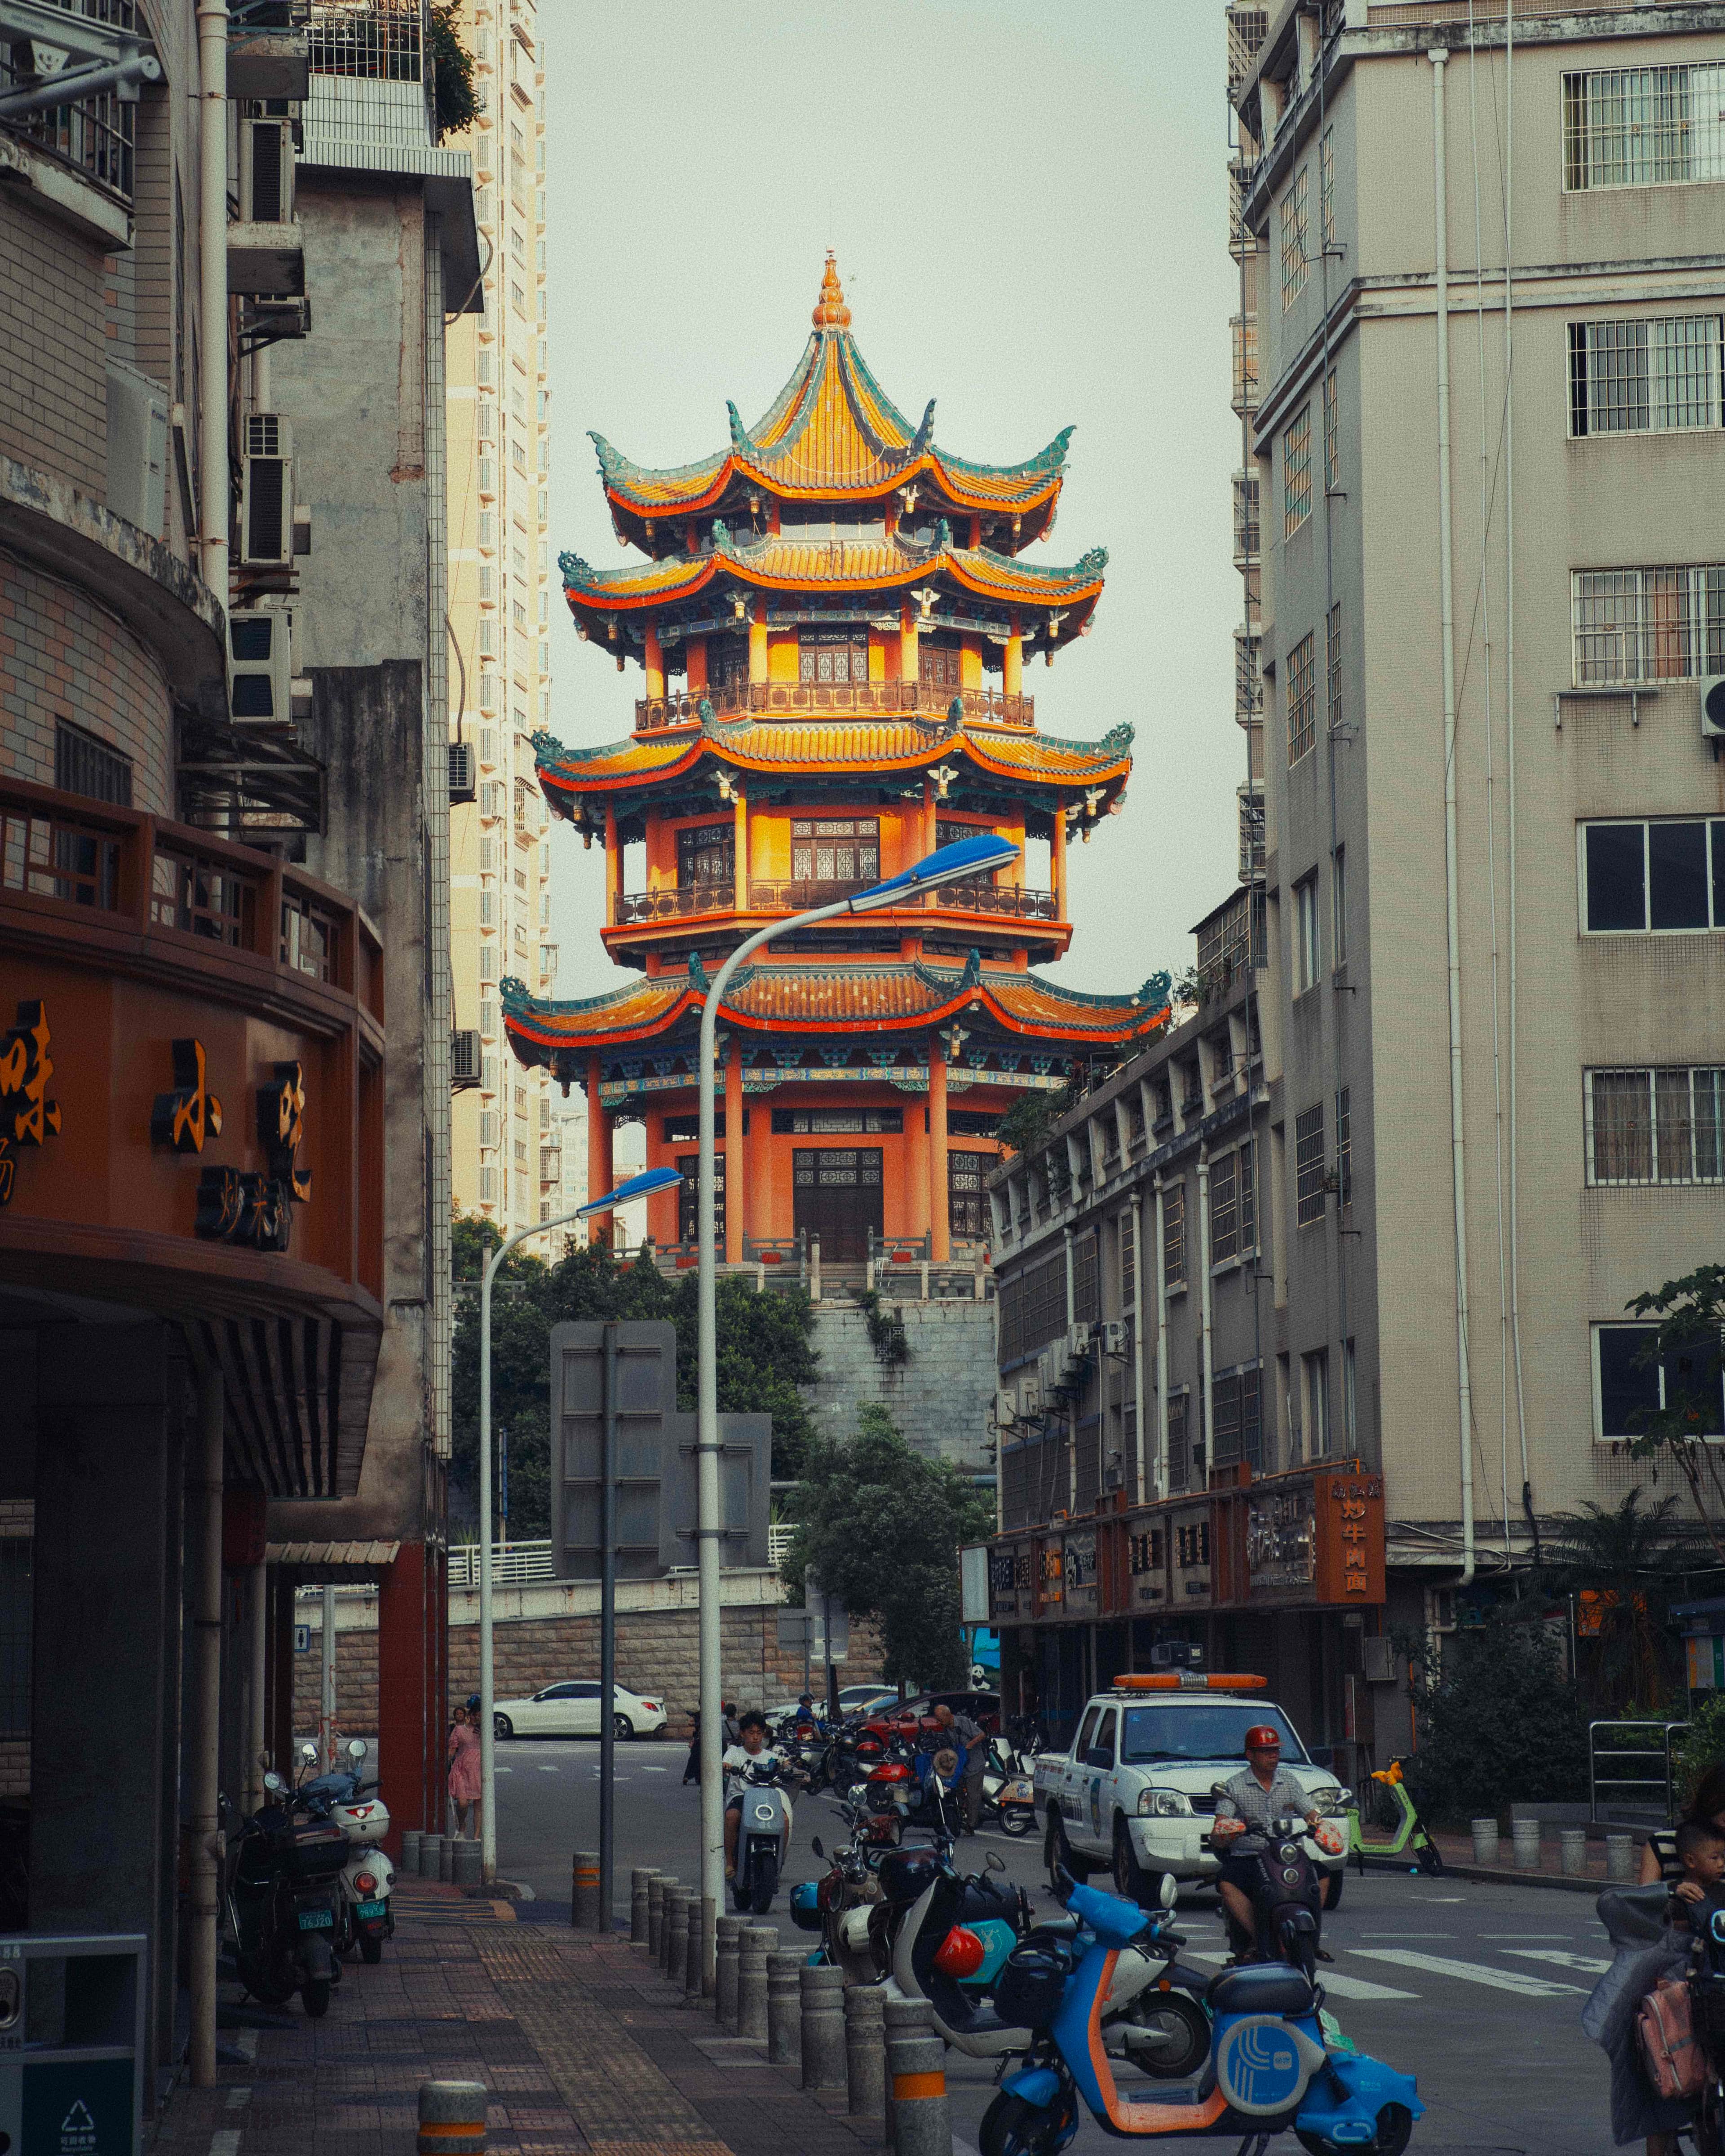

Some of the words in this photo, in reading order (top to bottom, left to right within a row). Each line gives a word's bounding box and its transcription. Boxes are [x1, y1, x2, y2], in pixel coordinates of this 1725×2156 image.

[1342, 1499, 1367, 1592] 炒牛肉面
[301, 1917, 331, 1929] 76J20
